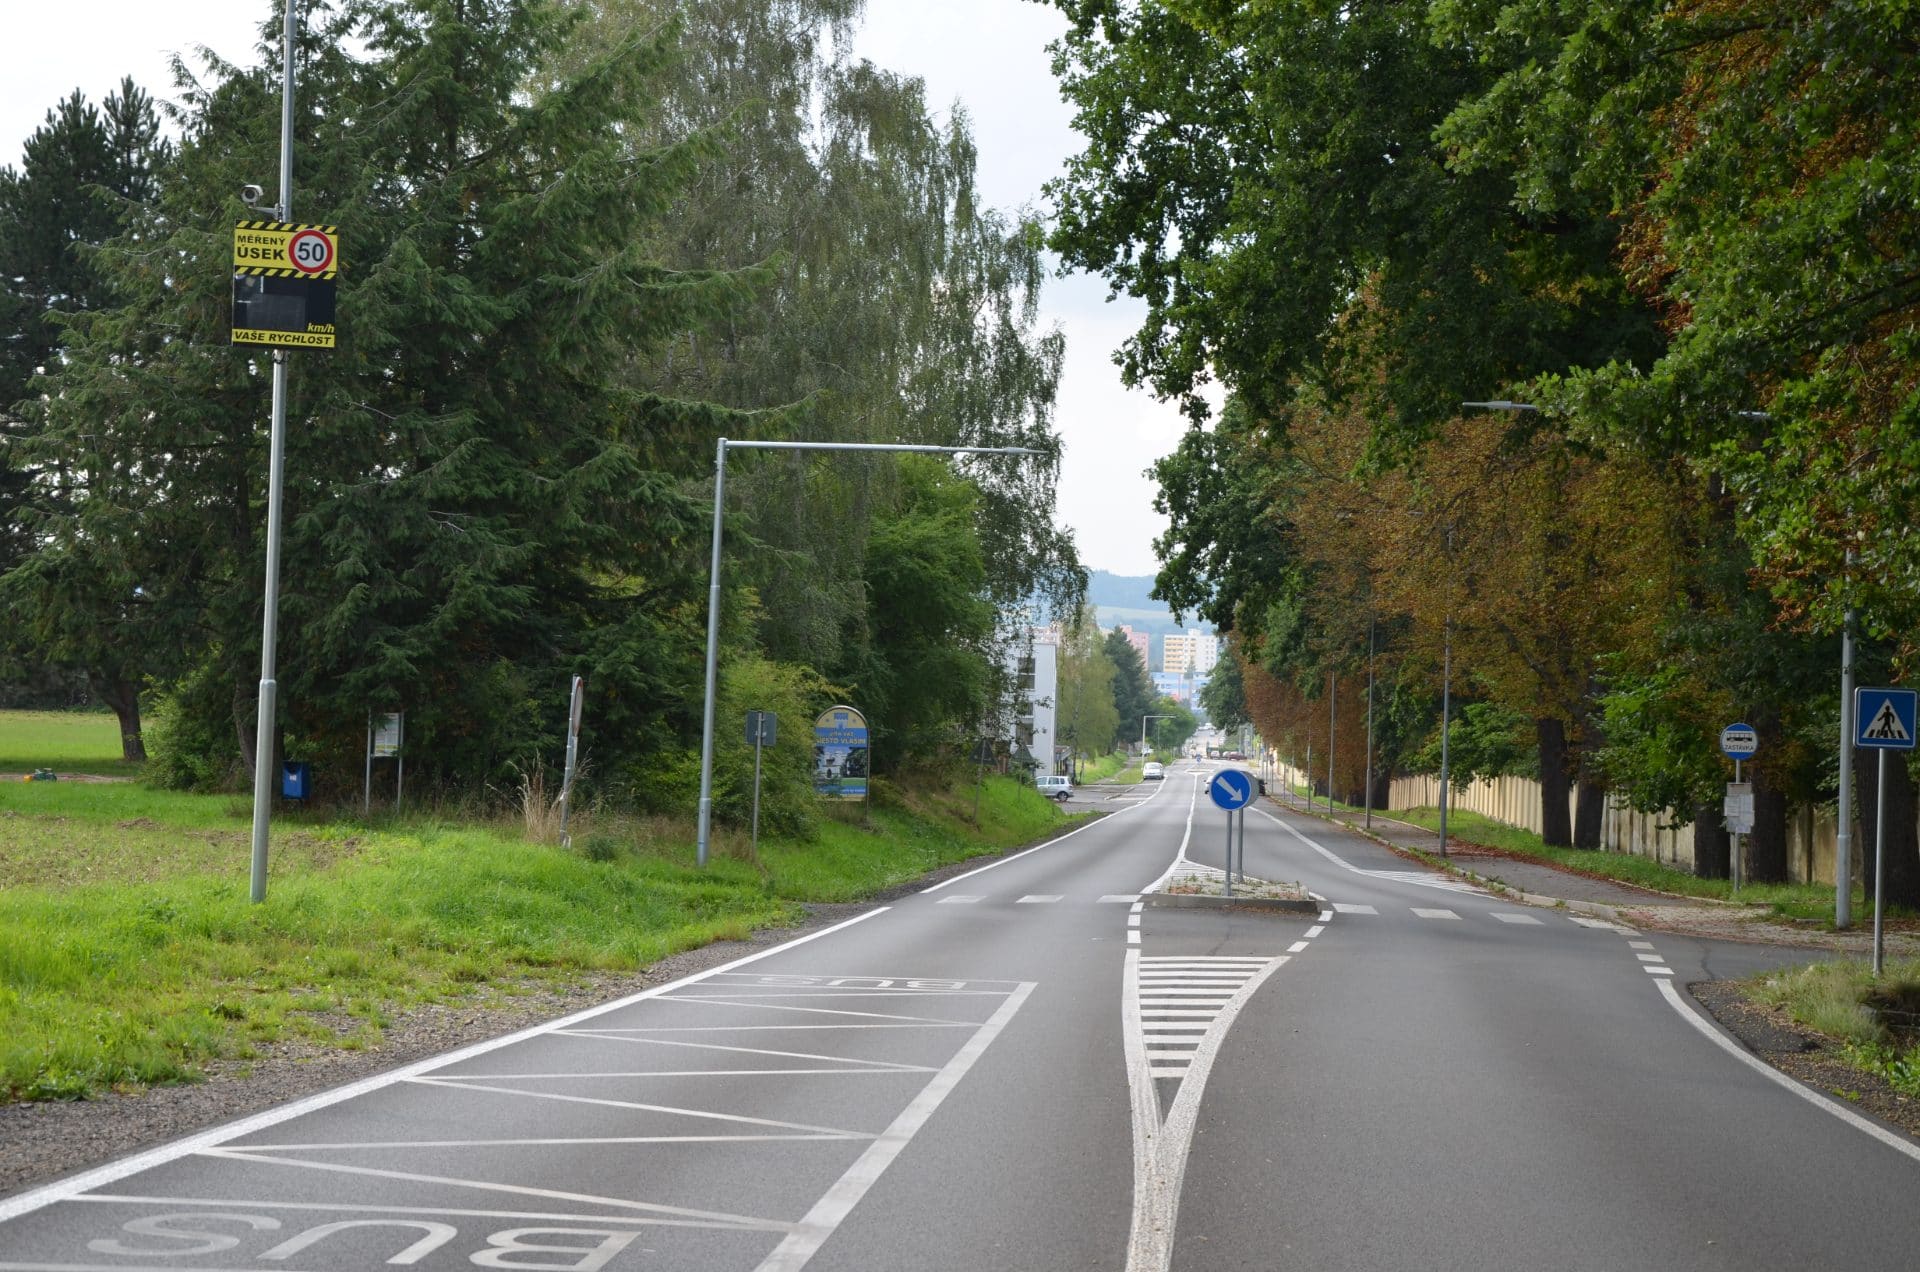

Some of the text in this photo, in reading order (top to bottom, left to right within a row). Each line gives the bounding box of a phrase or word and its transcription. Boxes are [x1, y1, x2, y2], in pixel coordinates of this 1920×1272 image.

[237, 244, 285, 261] ÚSEK
[297, 242, 325, 262] 50
[307, 322, 335, 334] km/h
[235, 331, 332, 345] VAŠE RYCHLOST
[757, 976, 968, 990] BUS
[86, 1211, 642, 1272] BUS
